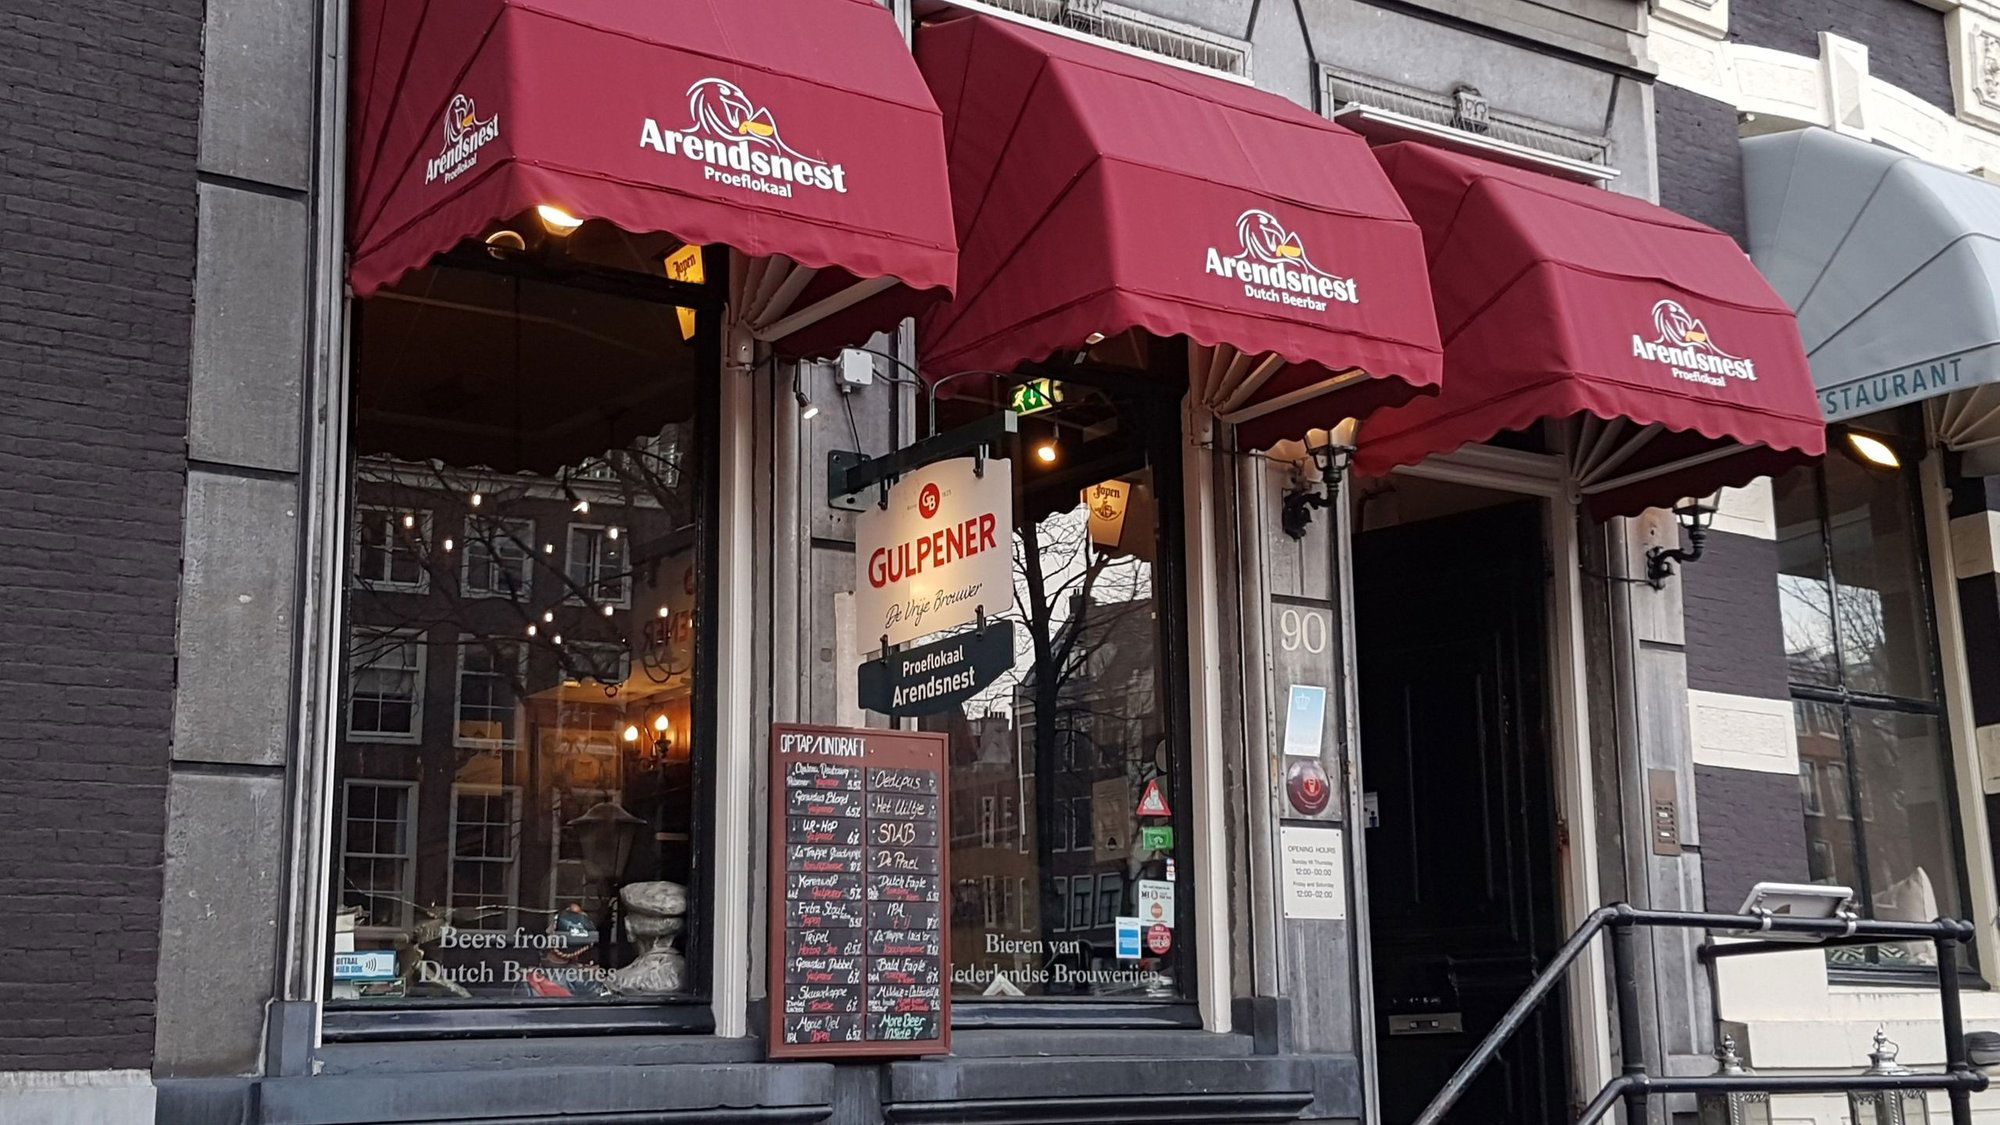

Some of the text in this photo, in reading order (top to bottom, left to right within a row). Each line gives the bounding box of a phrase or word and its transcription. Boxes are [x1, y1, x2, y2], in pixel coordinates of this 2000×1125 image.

[425, 112, 499, 185] Arendsnest
[640, 118, 848, 194] Arendsnest
[444, 154, 478, 184] Proeflokaal
[704, 165, 793, 198] Proeflokaal
[673, 254, 697, 279] Jopen
[1205, 247, 1360, 304] Arendsnest
[1244, 285, 1327, 311] Dutch Beerbar
[1632, 334, 1758, 381] Arendsnest
[1671, 367, 1726, 387] Proeflokaal
[1818, 358, 1962, 415] STAURANT
[1093, 484, 1121, 499] Jopen
[868, 512, 998, 589] GULPENER
[905, 599, 930, 627] Vrije
[934, 582, 983, 612] Brouwer
[1280, 608, 1327, 654] 90
[902, 645, 964, 678] Proeflokaal
[892, 666, 975, 708] Arendsnest
[875, 770, 921, 791] Oedipus
[876, 796, 891, 813] Het
[877, 851, 892, 868] De
[1288, 845, 1314, 853] OPENING
[878, 874, 904, 888] Dutch
[798, 901, 846, 915] Extra Stout
[887, 902, 905, 917] IPA
[440, 926, 505, 950] Beers
[513, 926, 568, 949] from
[985, 933, 1080, 954] Bieren van
[418, 960, 618, 983] Dutch Breweries
[877, 957, 900, 972] Bald
[1054, 963, 1160, 986] Brouwerijen
[879, 1012, 926, 1028] More Beer
